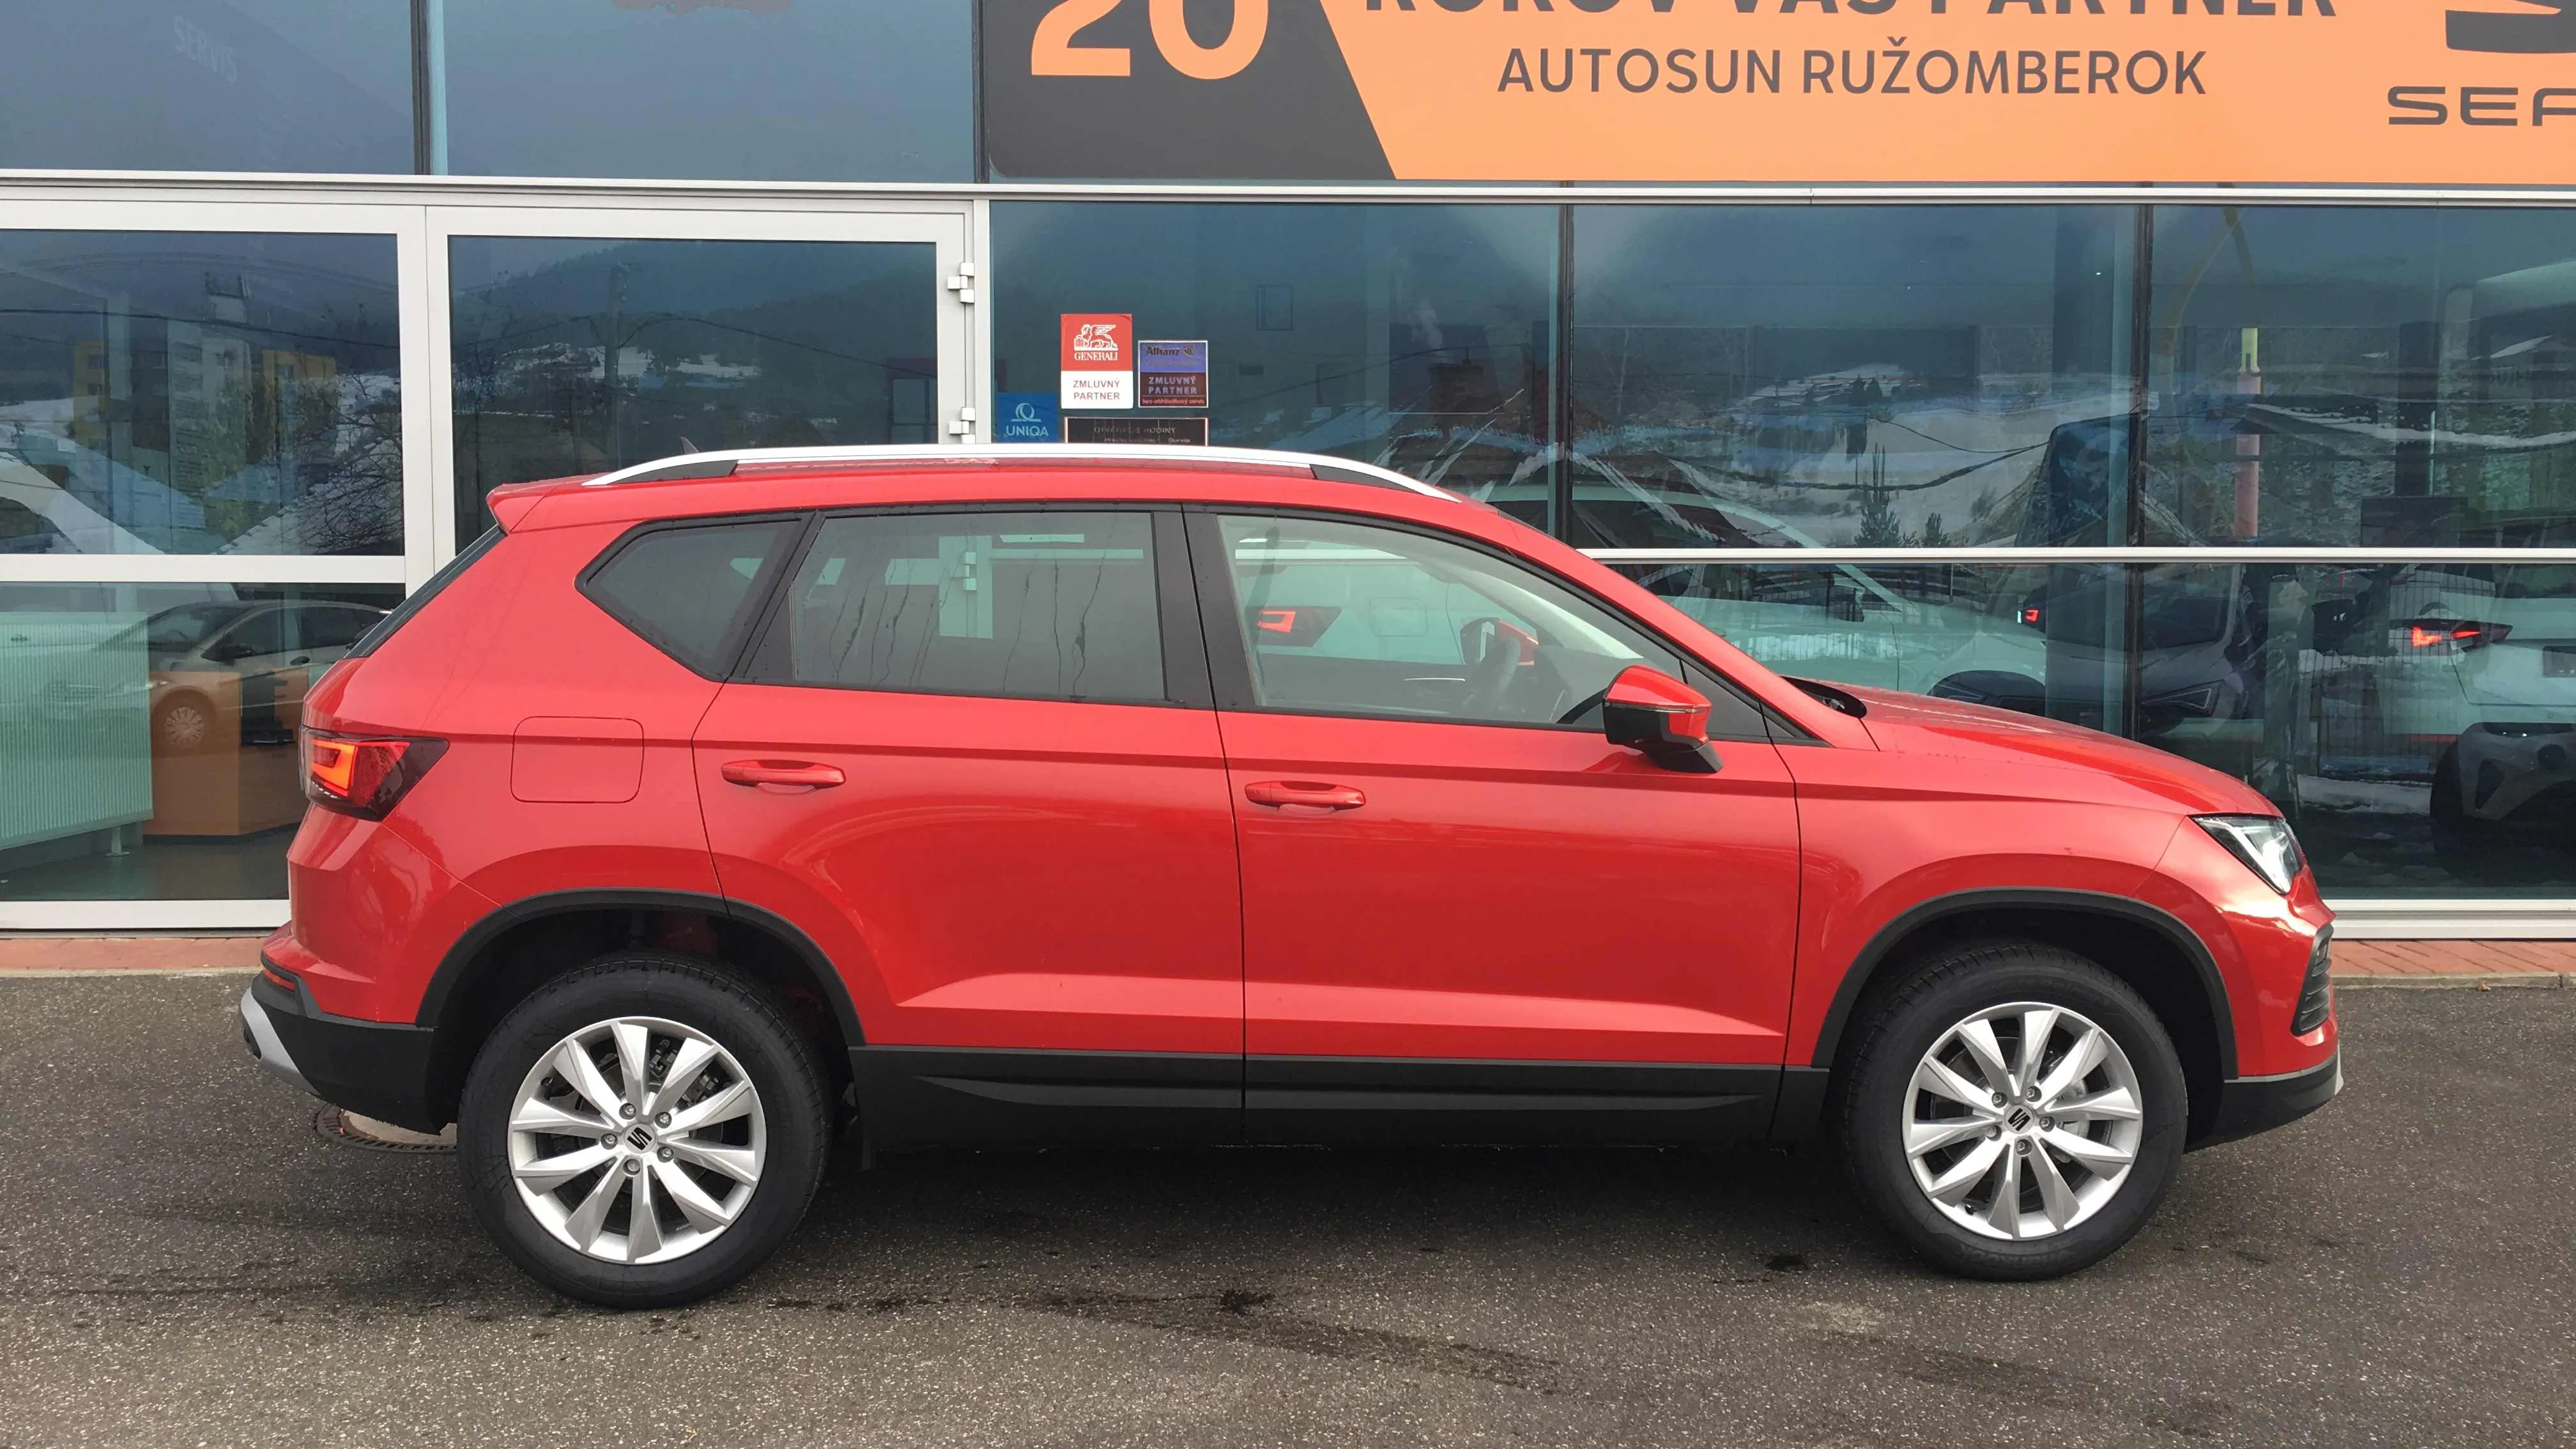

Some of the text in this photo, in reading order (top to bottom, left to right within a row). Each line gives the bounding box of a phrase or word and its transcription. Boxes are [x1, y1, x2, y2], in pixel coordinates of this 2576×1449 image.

[1032, 0, 1268, 79] 20
[172, 13, 238, 84] SERVIS
[1498, 37, 2205, 94] AUTOSUN RUŽOMBEROK
[1146, 347, 1179, 355] Allianz
[1074, 352, 1118, 362] GENERALI
[1073, 378, 1120, 388] ZMLUVNÝ
[1148, 376, 1197, 385] ZMLUVNÝ
[1073, 392, 1120, 400] PARTNER
[1006, 425, 1048, 436] UNIQA
